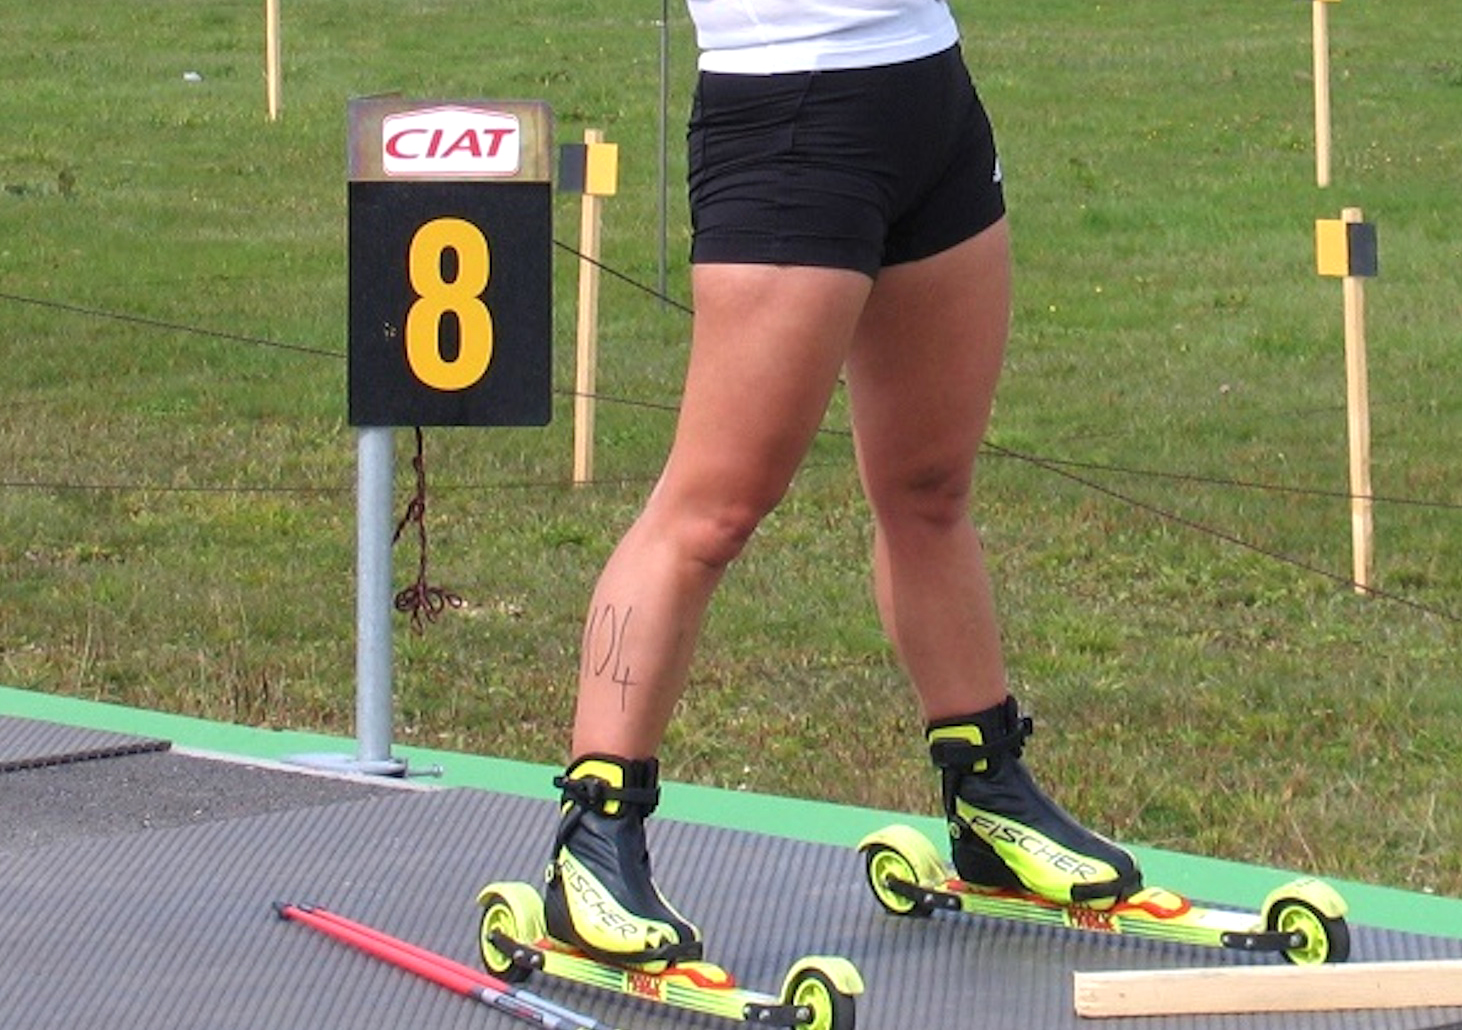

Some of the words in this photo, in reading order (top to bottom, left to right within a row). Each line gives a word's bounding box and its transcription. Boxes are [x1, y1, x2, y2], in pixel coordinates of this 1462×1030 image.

[385, 129, 515, 158] CIAT
[405, 216, 493, 391] 8
[970, 815, 1098, 880] FISCHER
[560, 858, 638, 939] FISCHER
